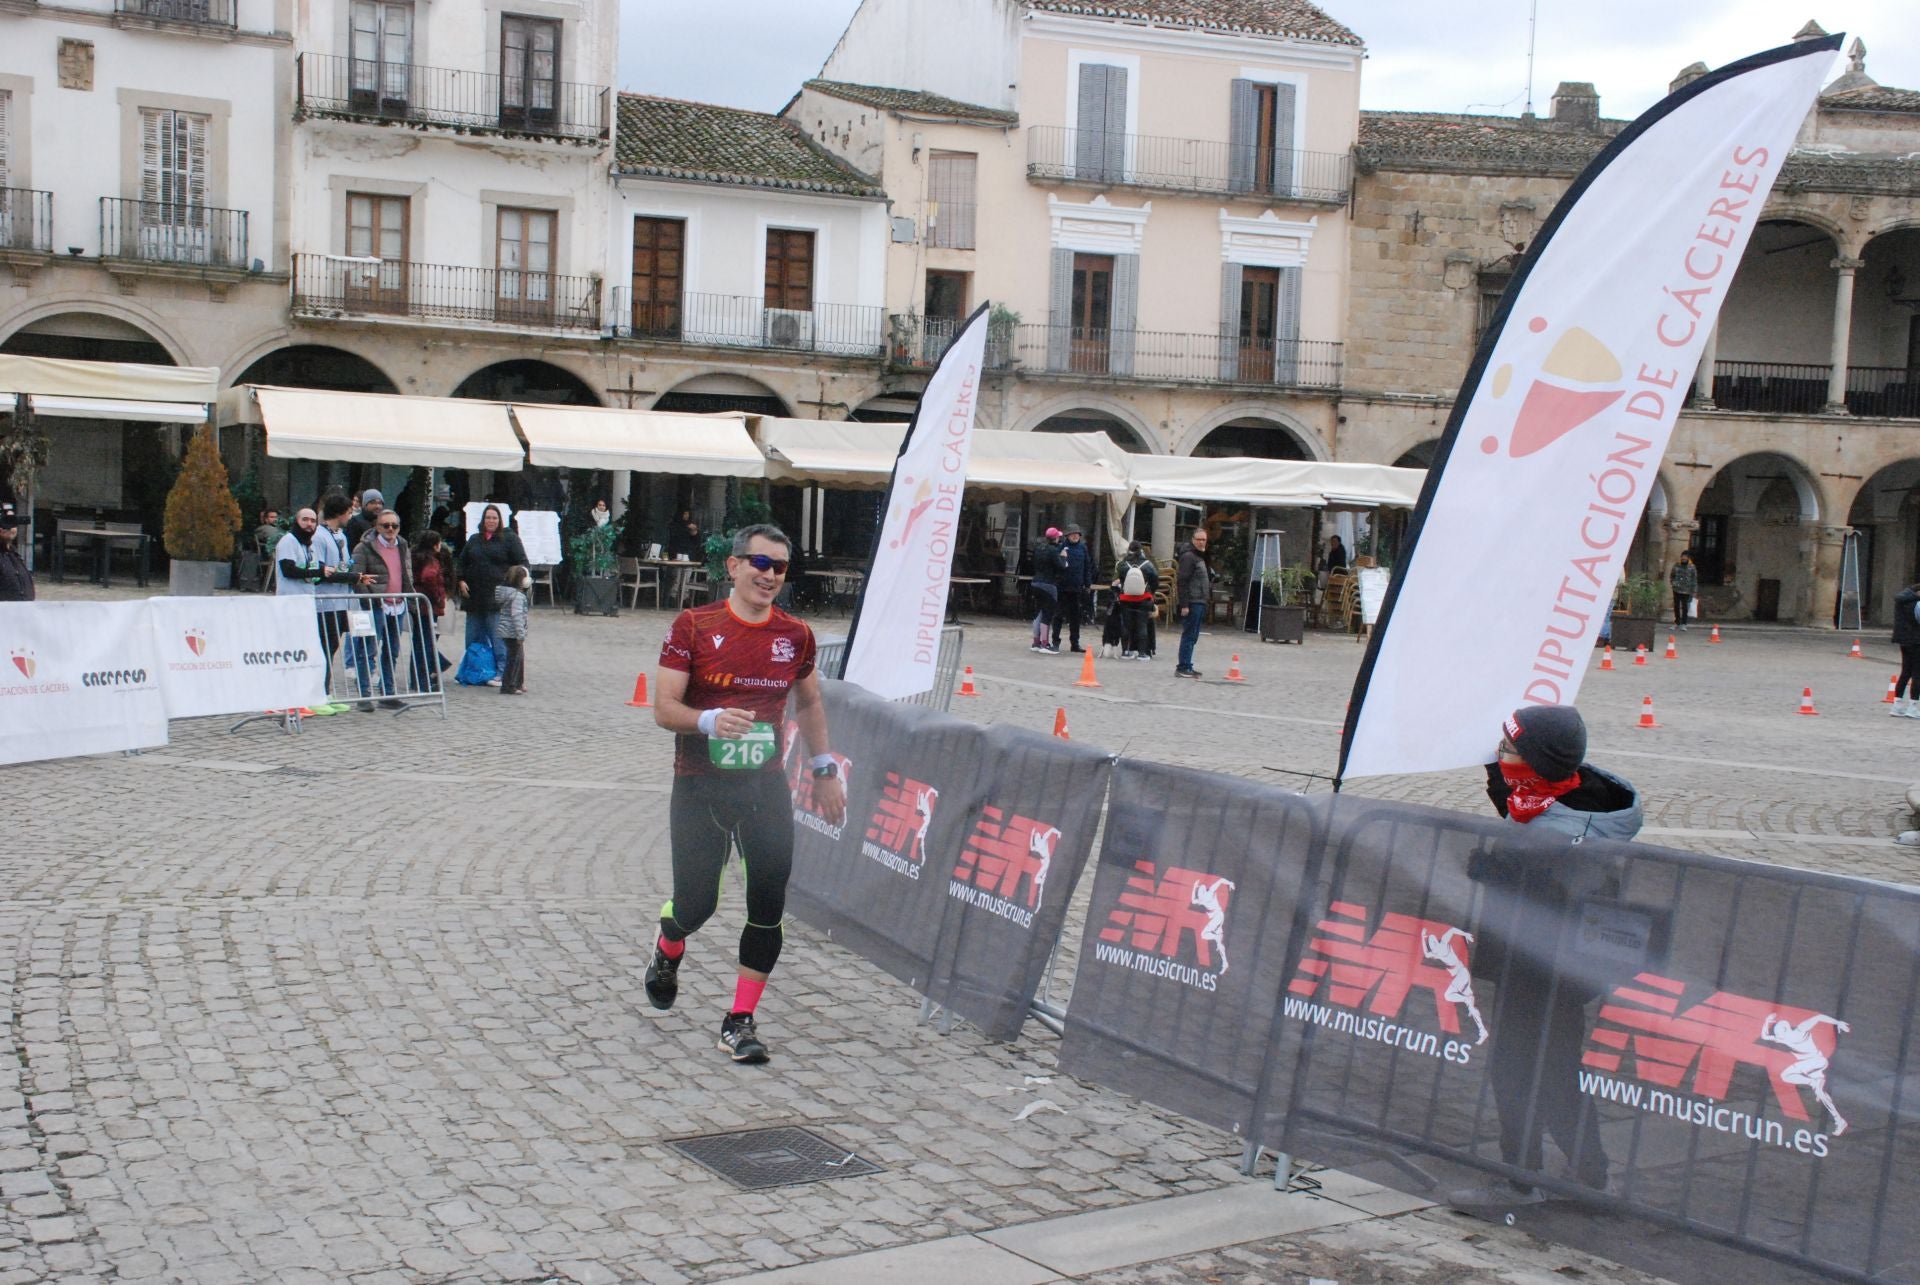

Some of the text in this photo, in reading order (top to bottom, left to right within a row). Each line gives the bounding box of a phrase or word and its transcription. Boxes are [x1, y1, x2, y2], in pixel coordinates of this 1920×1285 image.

[1523, 145, 1769, 706] DIPUTACIÓN DE CÁCERES
[914, 521, 952, 665] DIPUTACIÓN
[936, 483, 958, 513] DE
[733, 676, 788, 688] aquaducto
[721, 742, 764, 766] 216
[861, 840, 921, 880] www.musicrun.es
[949, 880, 1034, 928] www.musicrun.es
[1095, 943, 1217, 992] www.musicrun.es
[1284, 997, 1472, 1064] www.musicrun.es
[1578, 1070, 1829, 1157] www.musicrun.es
